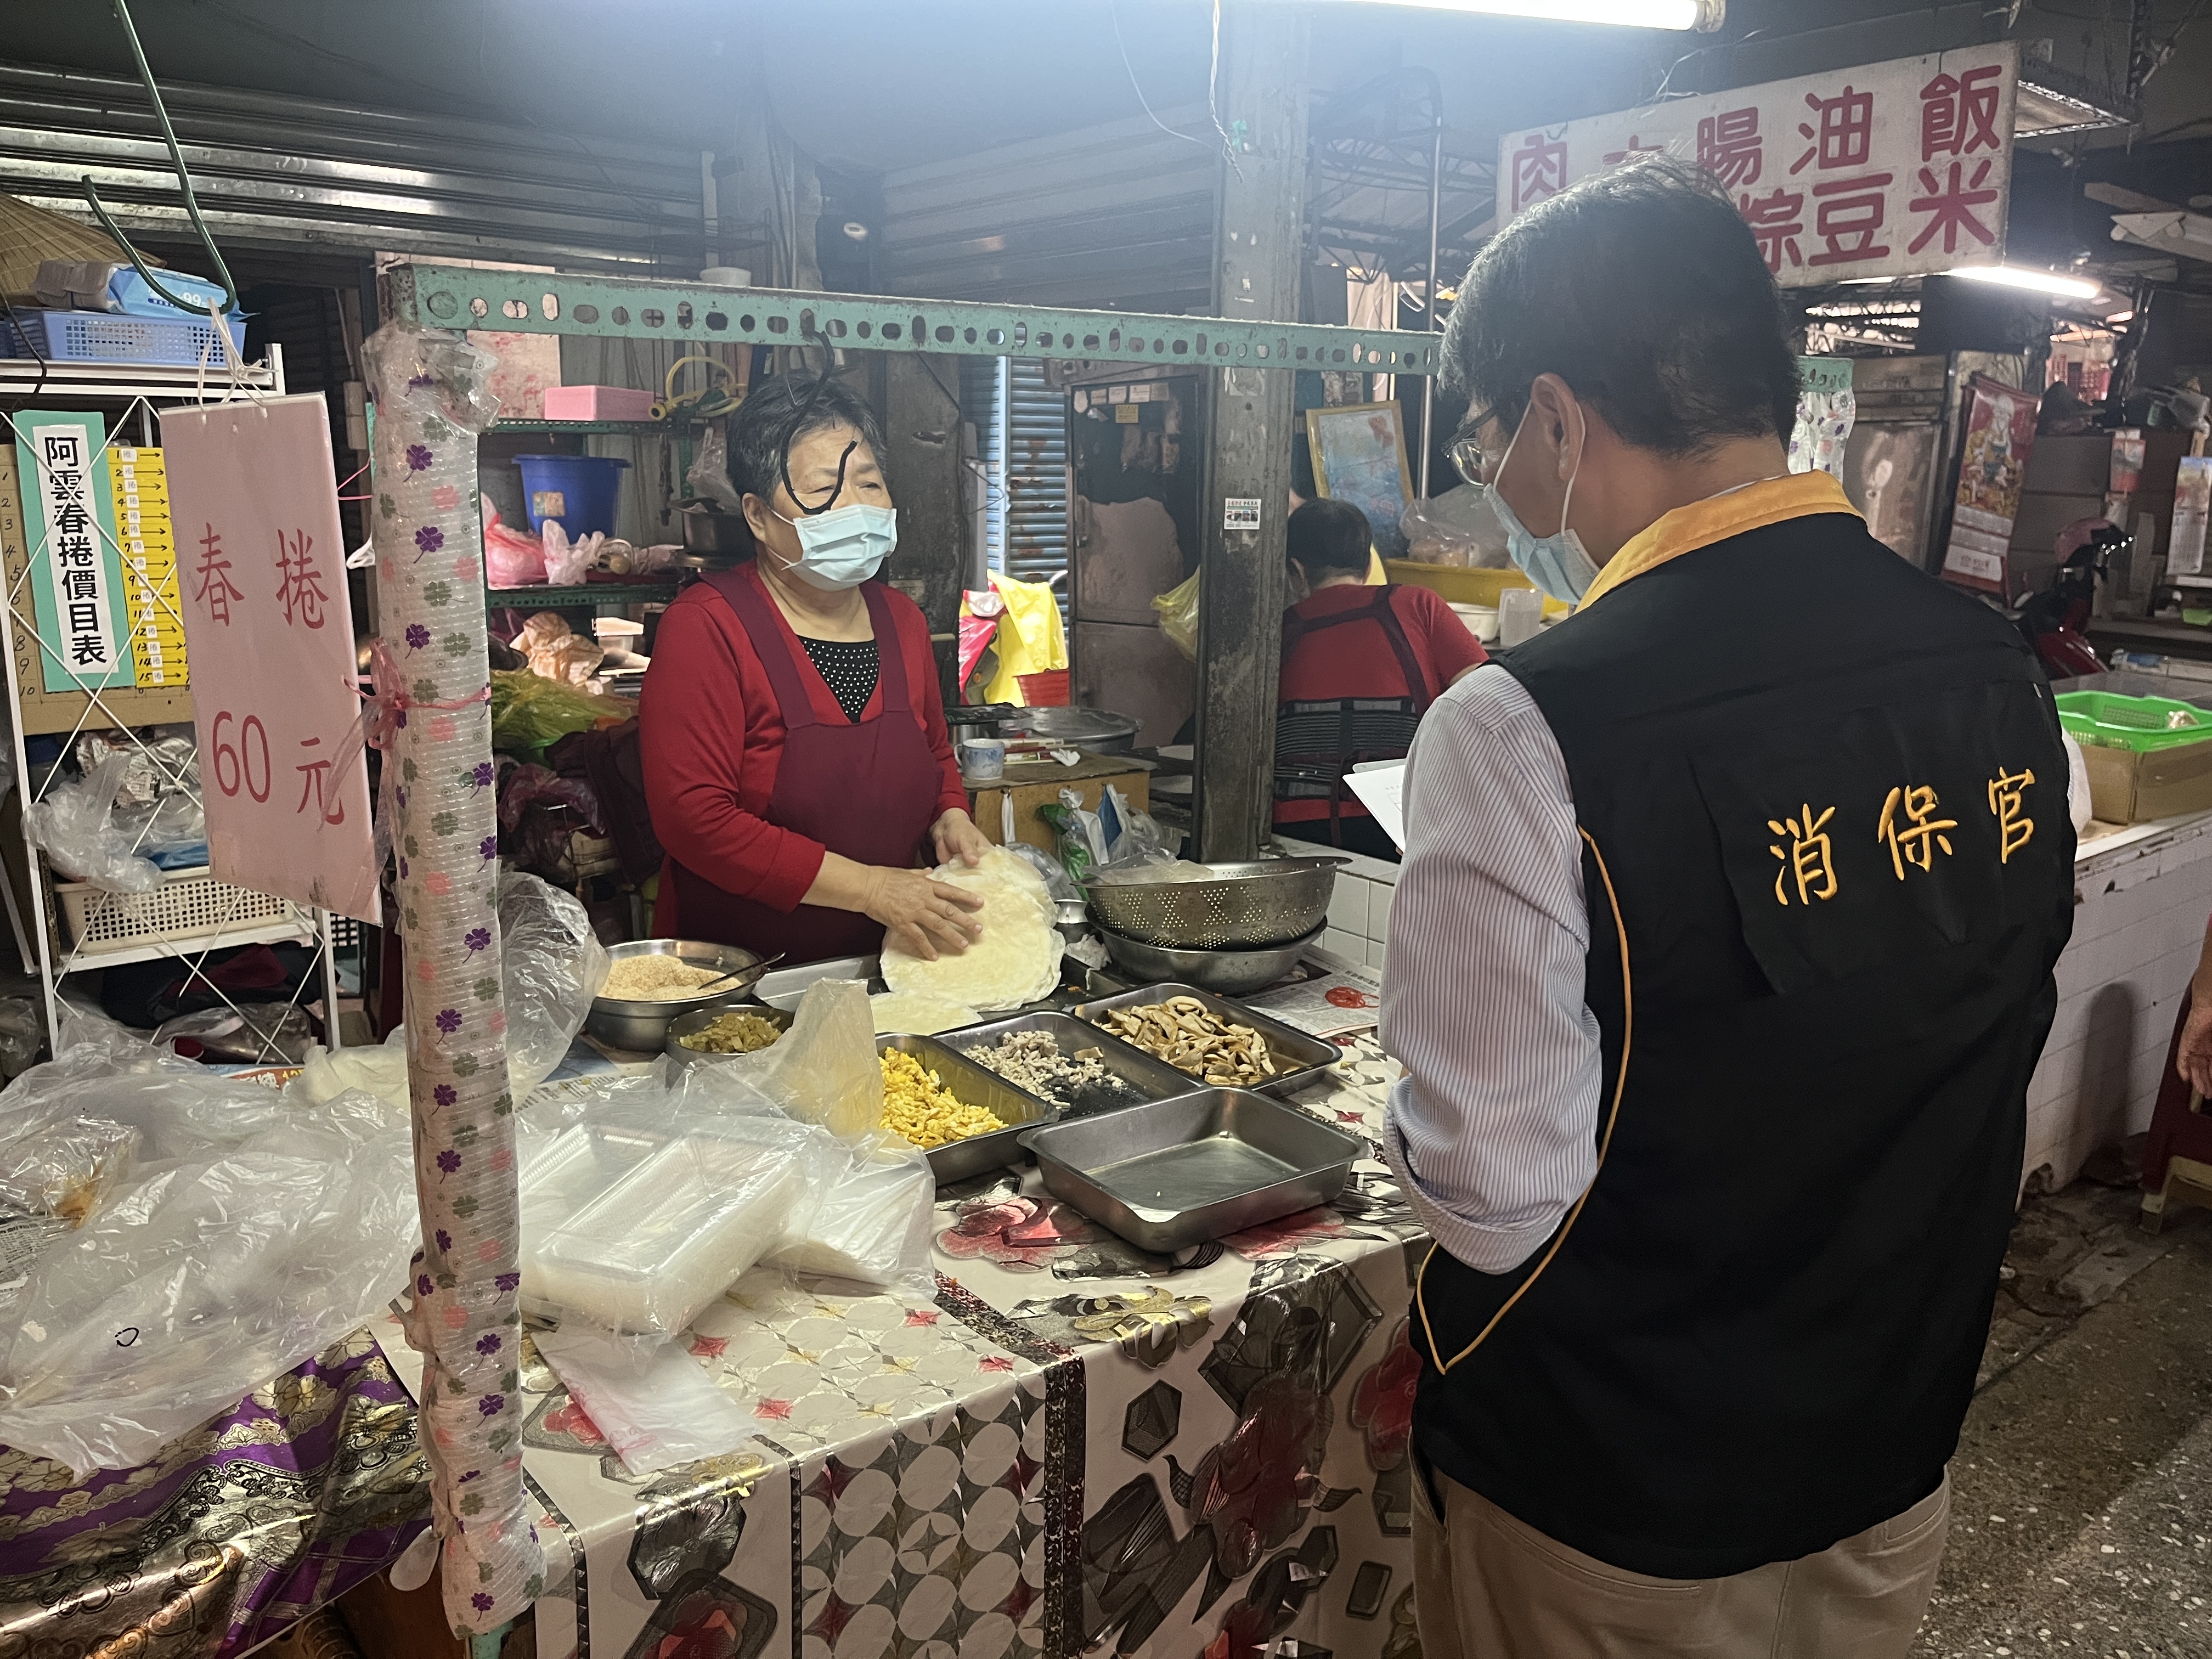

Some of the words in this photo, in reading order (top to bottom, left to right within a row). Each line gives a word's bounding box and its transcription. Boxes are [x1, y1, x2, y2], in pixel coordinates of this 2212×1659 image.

[116, 469, 123, 477] 2
[1, 498, 11, 507] 2
[117, 498, 126, 507] 4
[120, 512, 127, 521] 5
[4, 518, 13, 530] 3
[121, 527, 127, 535] 6
[5, 545, 17, 558] 4
[44, 436, 108, 666] 阿雲春捲價目表
[10, 564, 21, 581] 5
[195, 523, 330, 629] 春捲
[129, 575, 135, 587] 9
[15, 635, 25, 652] 8
[137, 642, 148, 652] 13
[20, 658, 30, 675] 9
[139, 658, 151, 667] 14
[139, 673, 153, 681] 15
[20, 686, 35, 697] 10
[1767, 766, 2035, 905] 消保官
